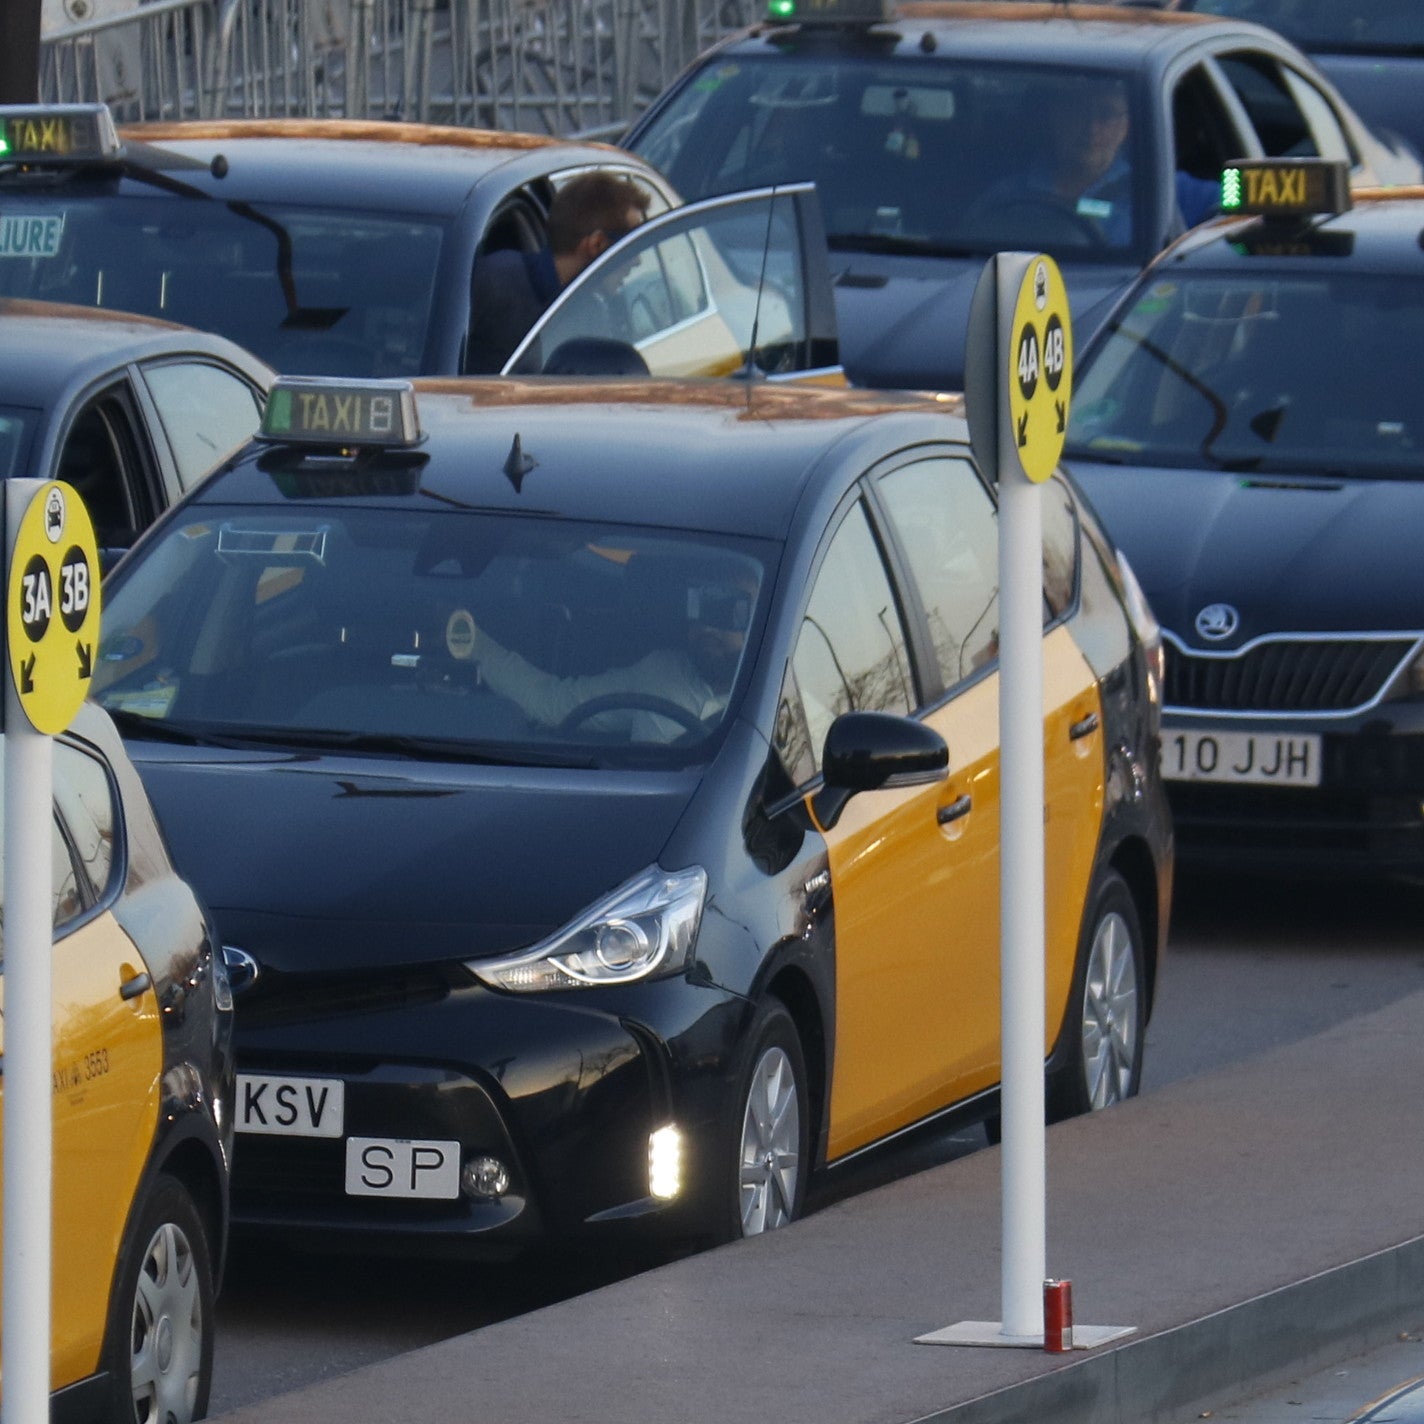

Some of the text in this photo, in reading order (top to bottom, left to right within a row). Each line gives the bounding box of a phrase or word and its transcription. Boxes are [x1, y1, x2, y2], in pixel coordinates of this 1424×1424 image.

[12, 118, 71, 153] TAXI
[1243, 169, 1306, 205] TAXI
[1018, 328, 1064, 384] 4A 4B
[299, 393, 362, 432] TAXI
[22, 562, 88, 624] 3A 3B
[1154, 735, 1309, 778] 10 JJH
[84, 1047, 109, 1081] 3553
[243, 1081, 329, 1129] KSV
[360, 1145, 445, 1191] SP
